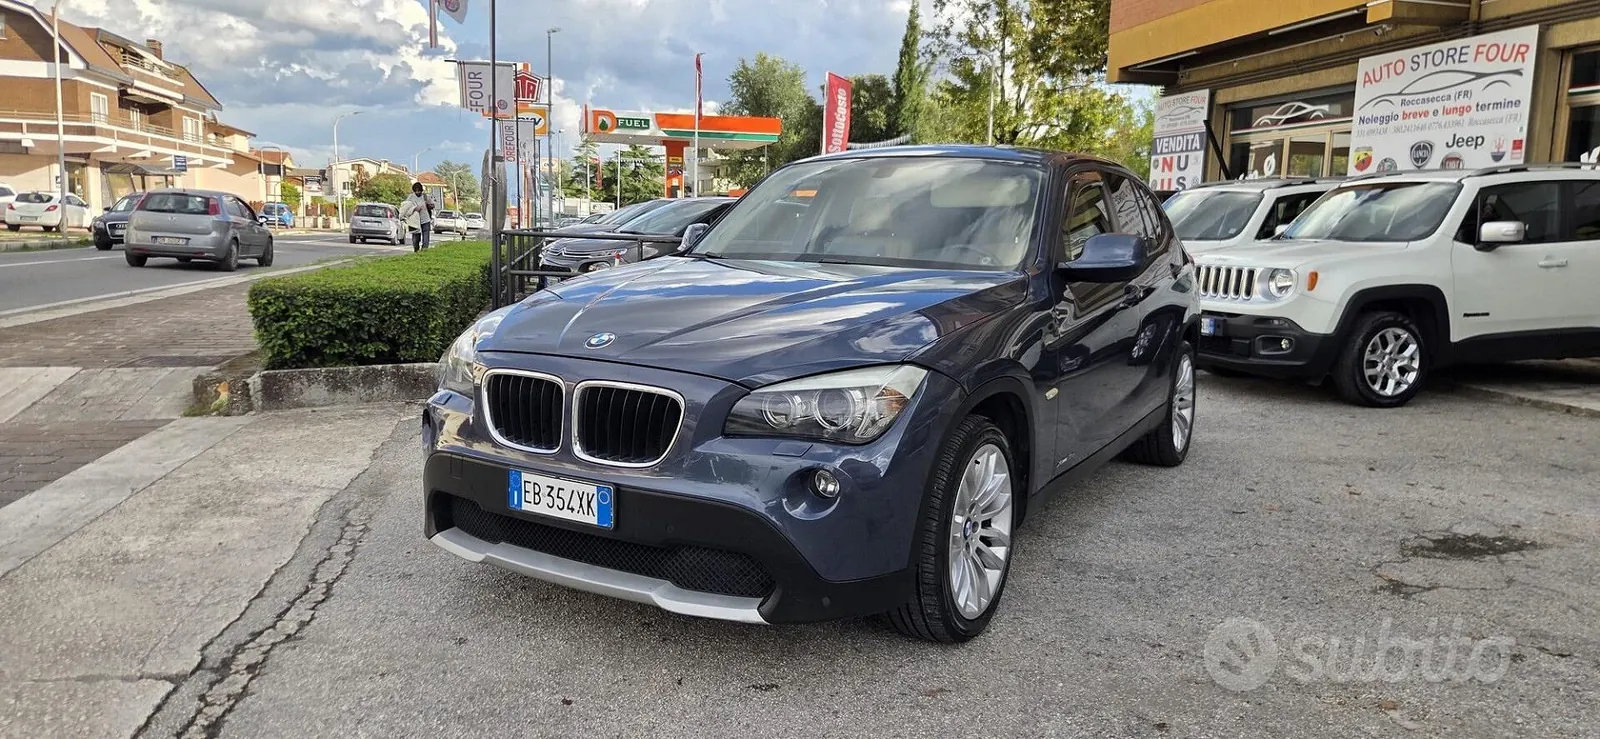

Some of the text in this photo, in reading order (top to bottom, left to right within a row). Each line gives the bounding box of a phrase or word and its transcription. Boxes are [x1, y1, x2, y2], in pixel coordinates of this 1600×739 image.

[1362, 43, 1530, 88] AUTO STORE FOUR
[468, 71, 484, 112] FOUR
[1400, 89, 1473, 107] Roccasecca (FR)
[618, 118, 649, 129] FUEL
[1358, 98, 1521, 126] Noleggio breve e lungo termine
[1156, 133, 1200, 154] VENDITA
[1446, 133, 1485, 149] Jeep
[524, 480, 595, 517] EB 354XK
